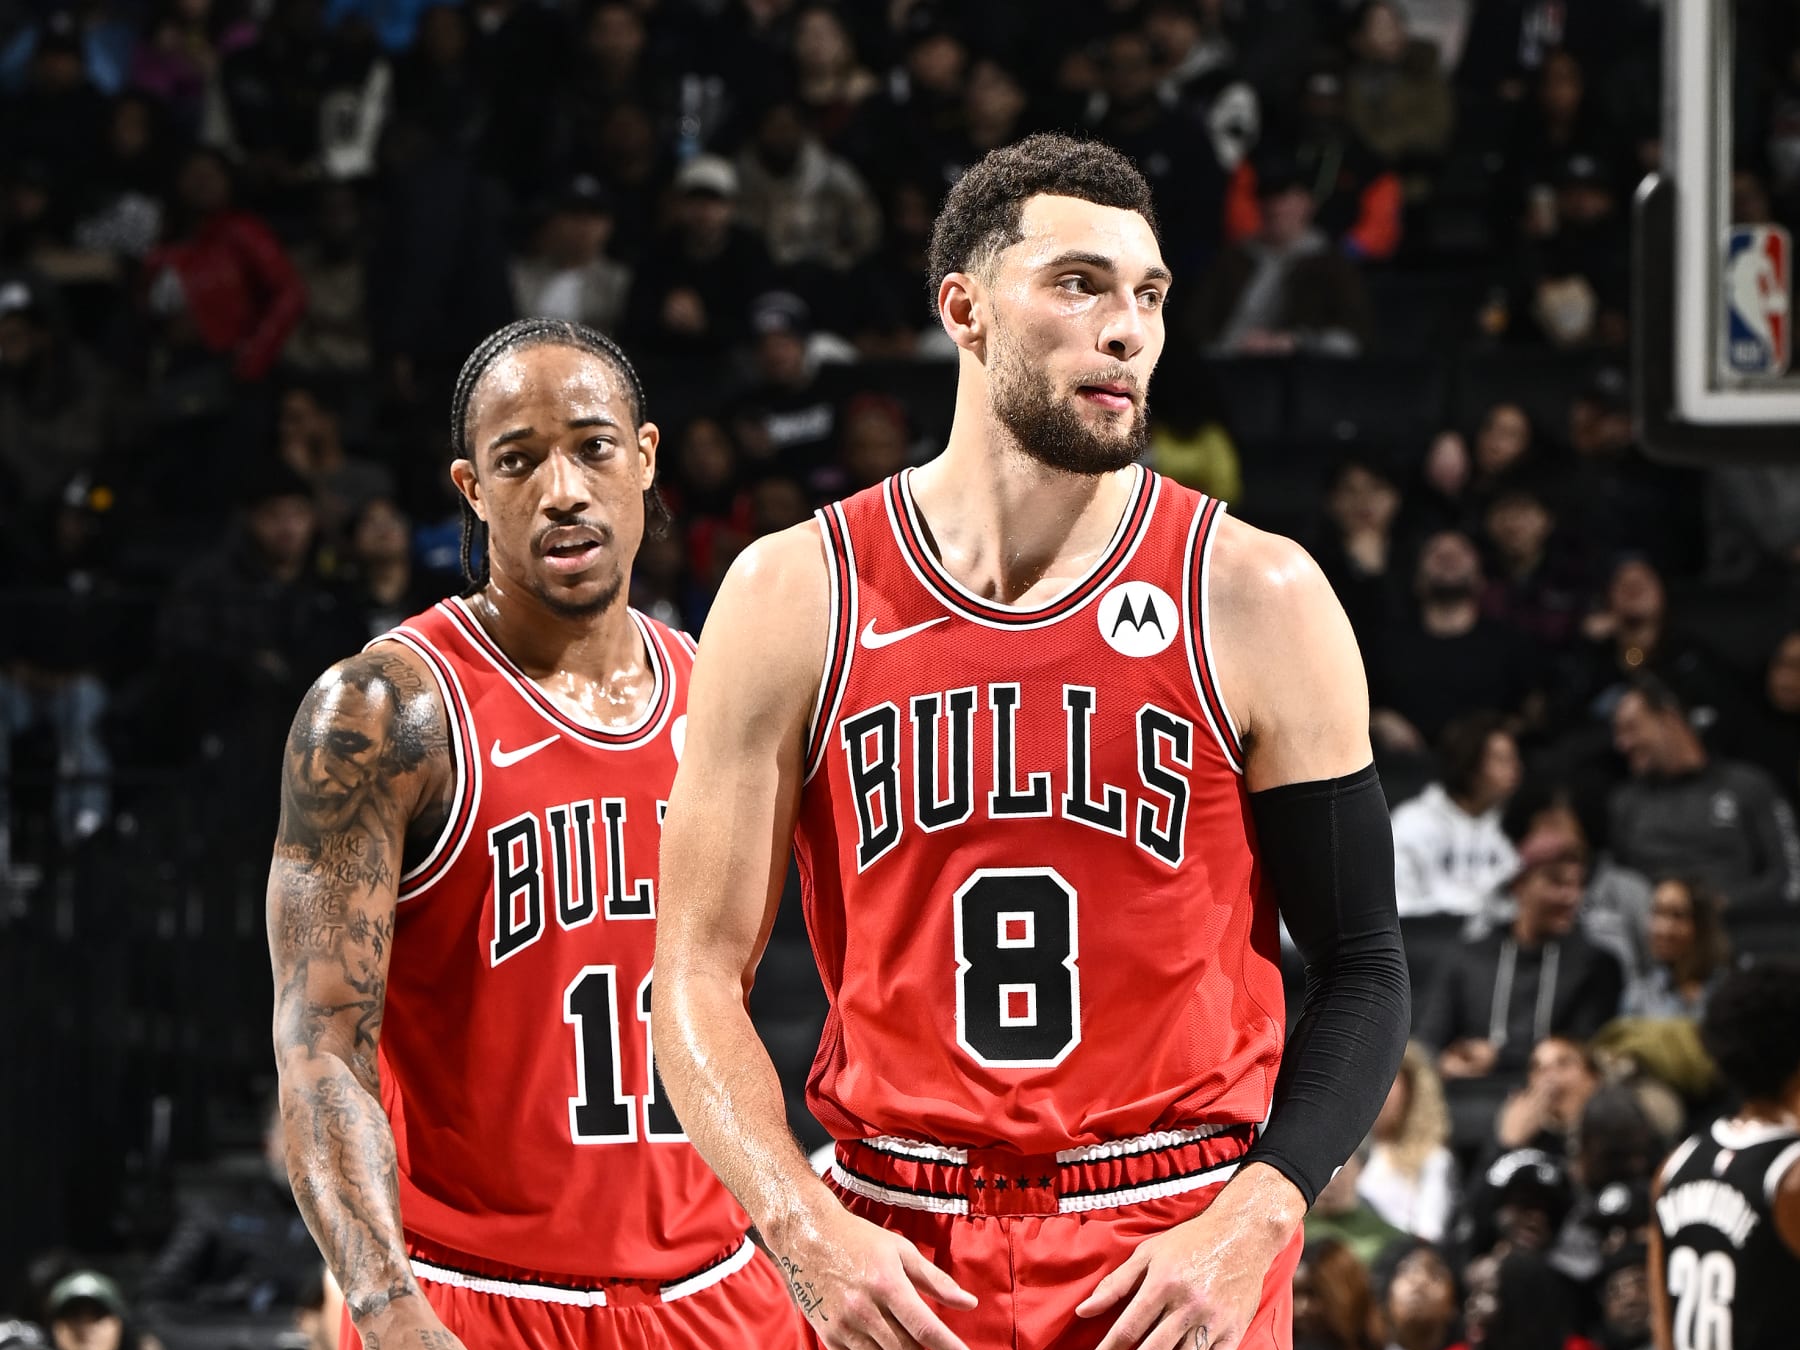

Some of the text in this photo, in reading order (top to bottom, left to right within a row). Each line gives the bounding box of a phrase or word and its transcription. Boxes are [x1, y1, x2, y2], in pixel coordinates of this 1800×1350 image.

[840, 682, 1193, 874] BULLS
[487, 797, 668, 968] BUL
[953, 867, 1082, 1069] 8
